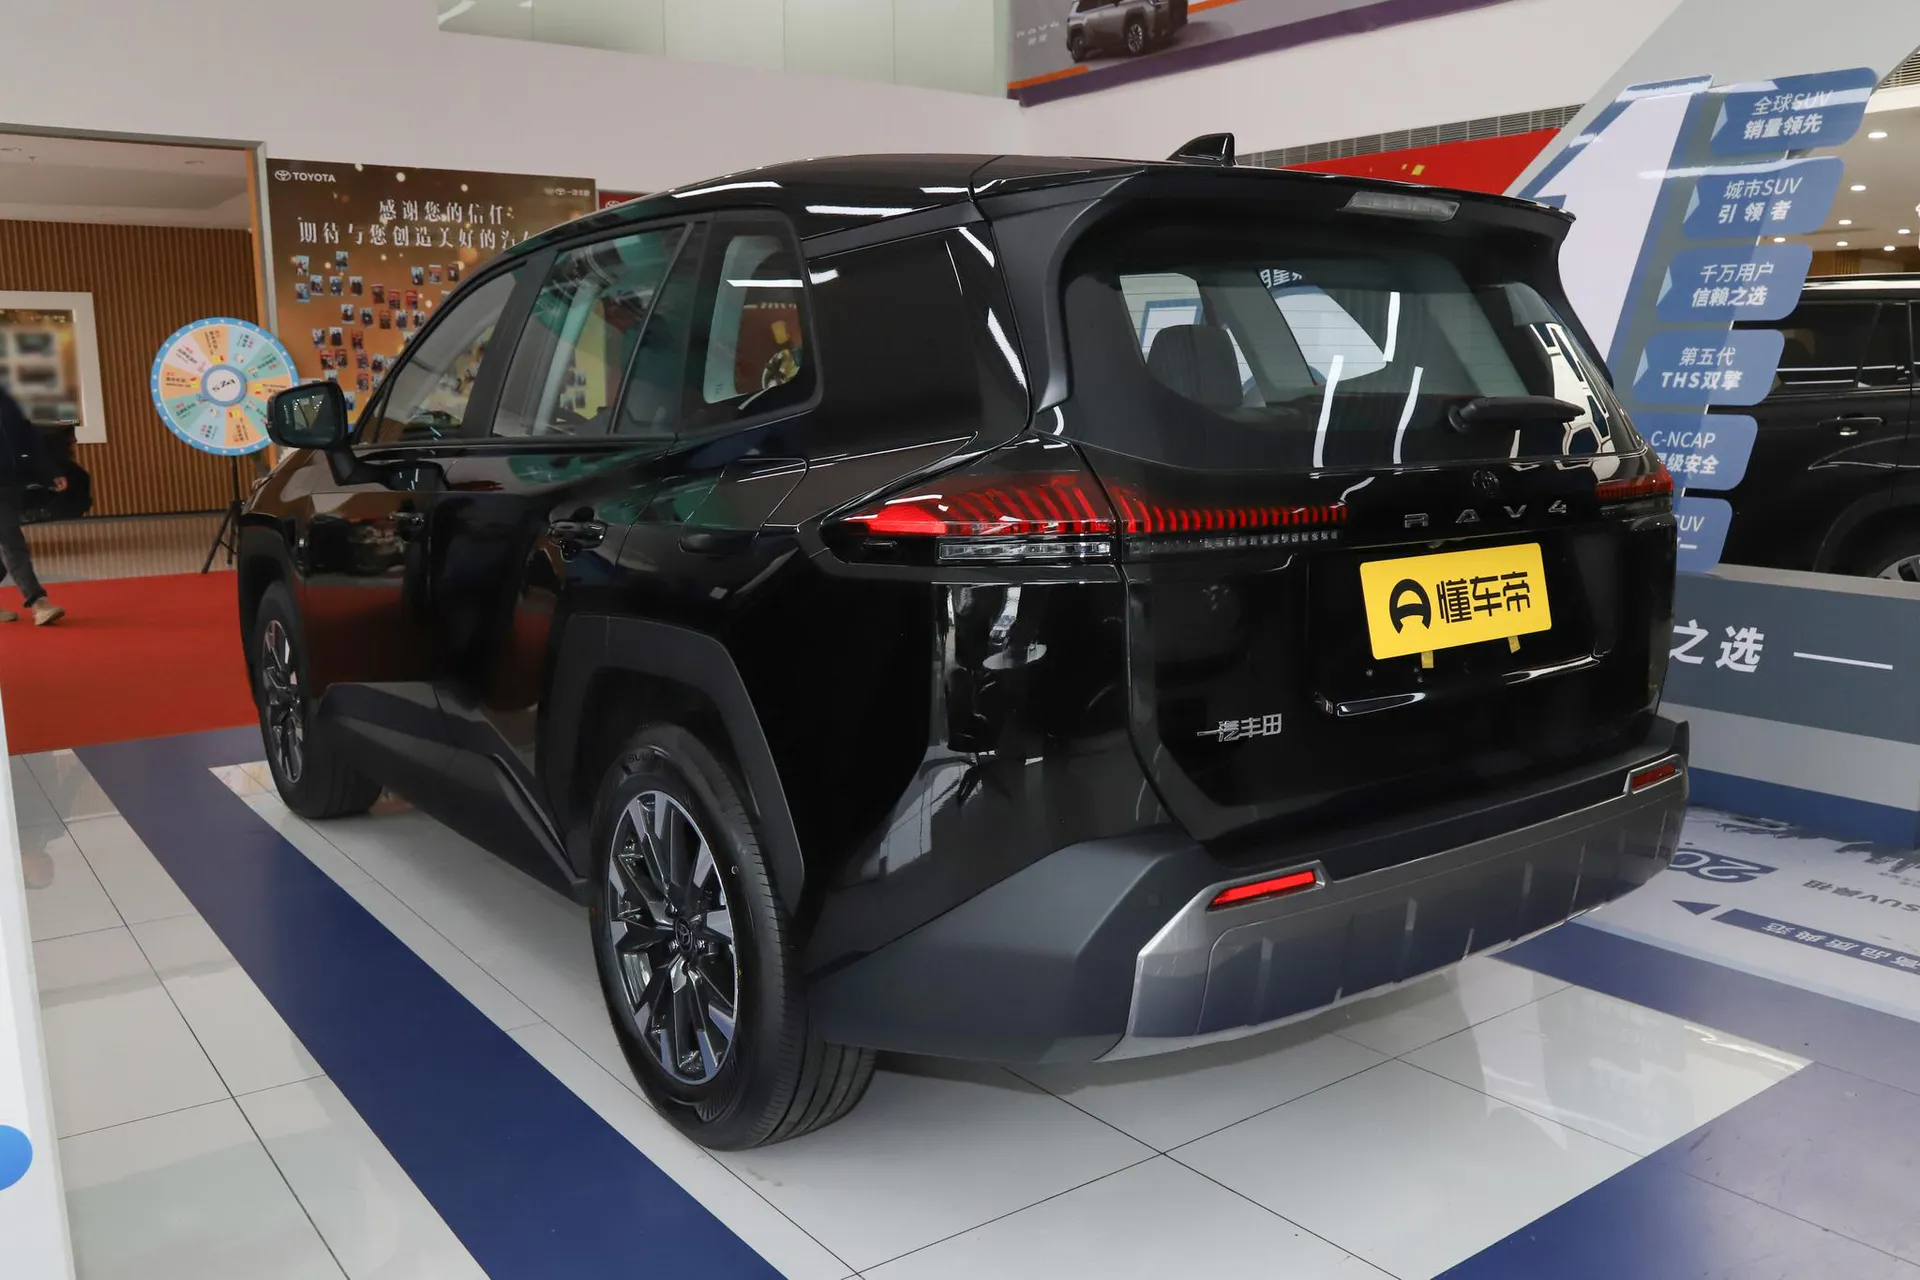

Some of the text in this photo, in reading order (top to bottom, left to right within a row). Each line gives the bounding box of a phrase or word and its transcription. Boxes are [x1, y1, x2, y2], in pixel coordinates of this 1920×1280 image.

[1743, 114, 1823, 140] 销量领先
[292, 172, 337, 182] TOYOTA
[1724, 177, 1803, 200] 城市SUV
[379, 200, 504, 225] 感谢您的信任
[1718, 200, 1792, 224] 引领者
[1699, 261, 1774, 284] 千万用户
[1692, 286, 1768, 308] 信赖之选
[1678, 346, 1736, 367] 第五代
[1661, 370, 1743, 391] THS双擎
[1651, 431, 1716, 448] C-NCAP
[1404, 500, 1567, 528] RAV4
[1436, 571, 1531, 624] 懂车帝
[1669, 619, 1764, 673] 之选
[1196, 713, 1282, 742] 一汽丰田
